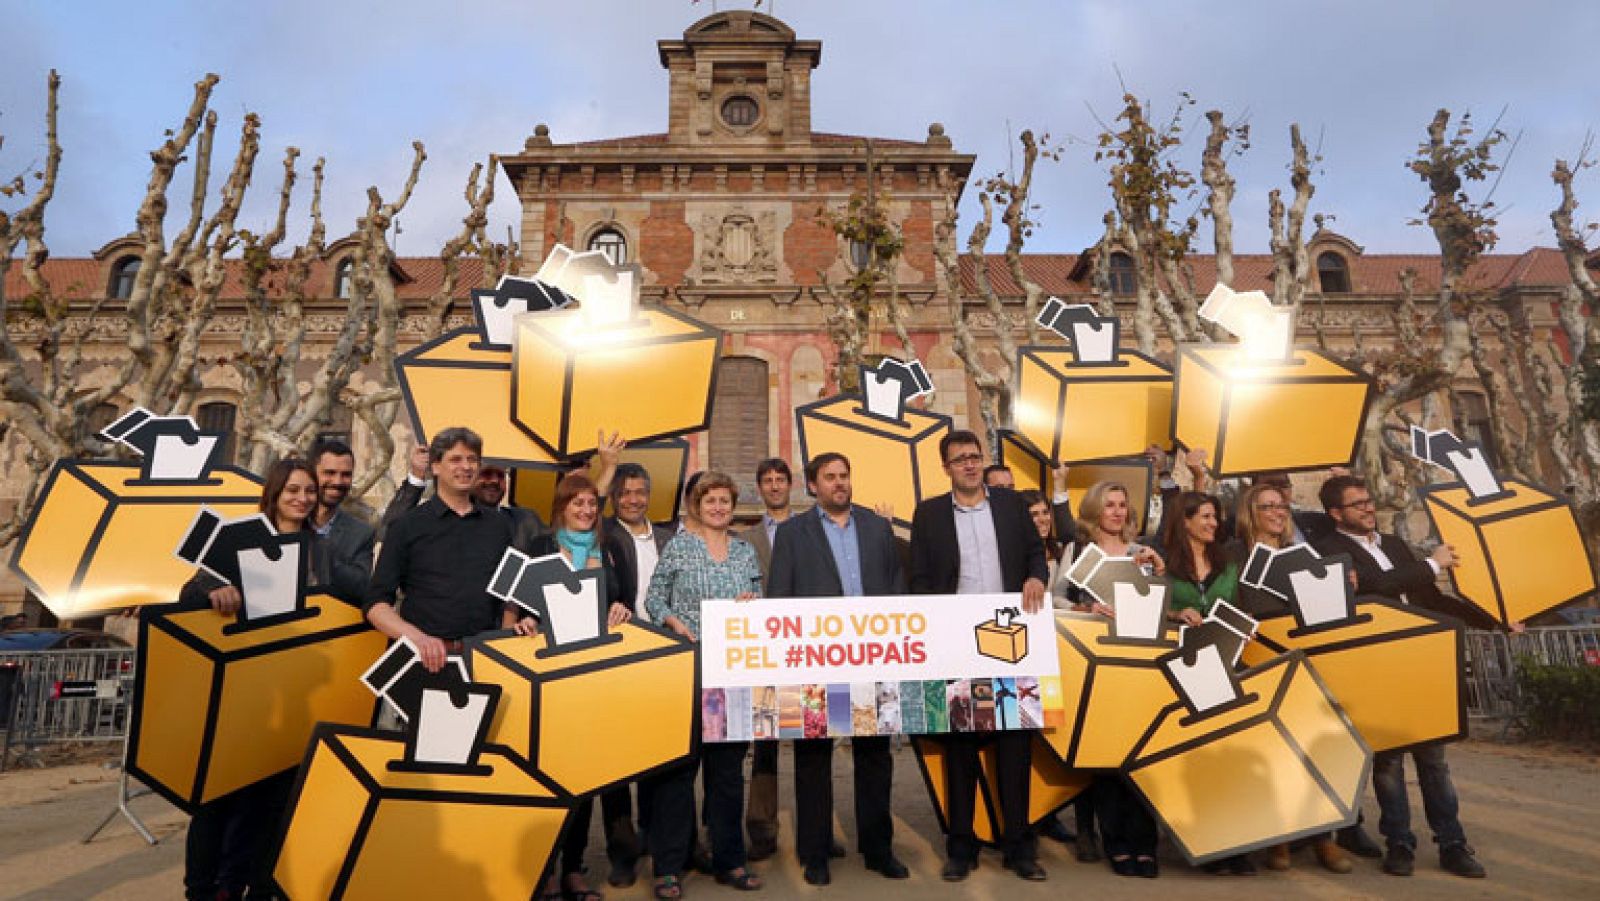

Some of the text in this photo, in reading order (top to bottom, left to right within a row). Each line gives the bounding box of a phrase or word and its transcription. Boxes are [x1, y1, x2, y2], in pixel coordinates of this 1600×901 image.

[725, 612, 928, 641] EL 9N JO VOTO
[725, 635, 928, 670] PEL #NOUPAÍS
